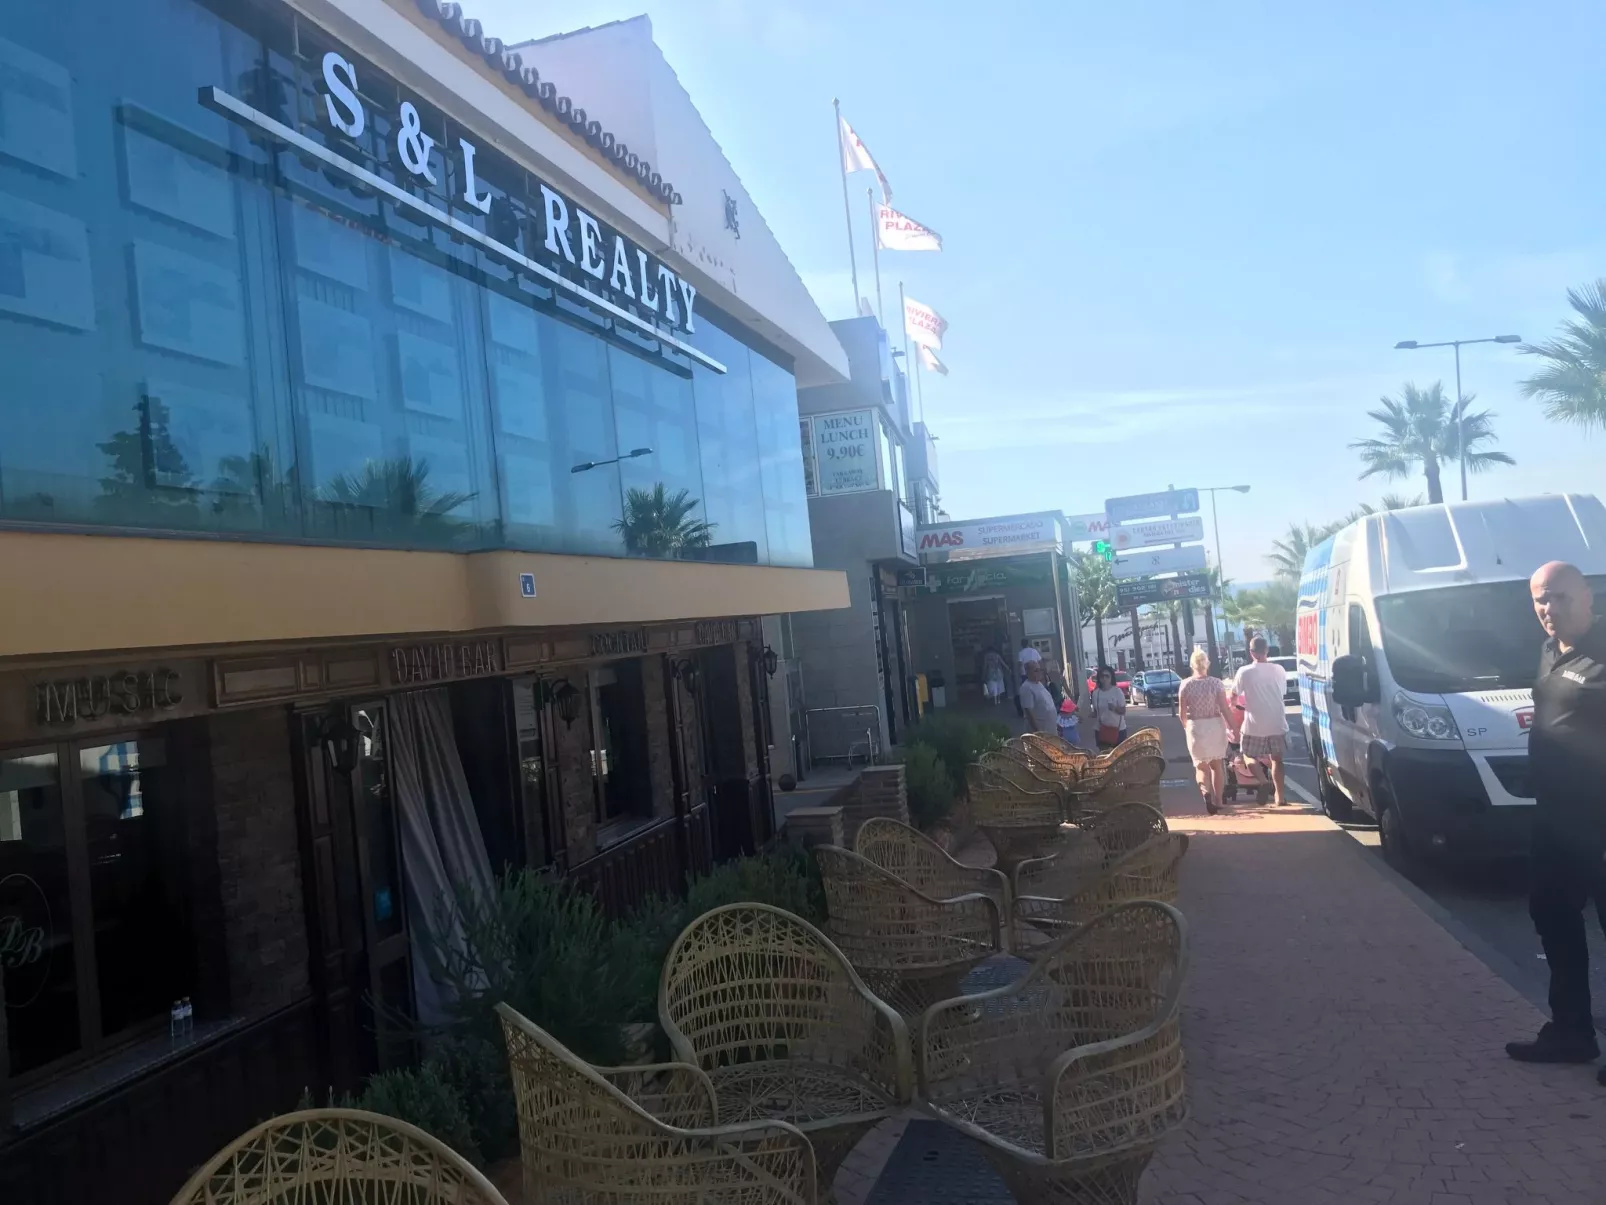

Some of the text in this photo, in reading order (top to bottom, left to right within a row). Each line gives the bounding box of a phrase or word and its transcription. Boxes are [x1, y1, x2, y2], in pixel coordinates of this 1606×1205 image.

[321, 51, 364, 139] S
[397, 101, 437, 186] &
[458, 138, 492, 216] L
[540, 183, 697, 335] REALTY
[823, 415, 863, 430] MENU
[820, 428, 869, 443] LUNCH
[826, 444, 865, 460] 9.90€
[977, 520, 1044, 536] SUPERMERCADO
[920, 530, 964, 550] MAS
[982, 531, 1041, 546] SUPERMARKET
[393, 641, 501, 684] DAVID BAR
[43, 670, 184, 722] MUSIC
[1467, 727, 1488, 737] SP
